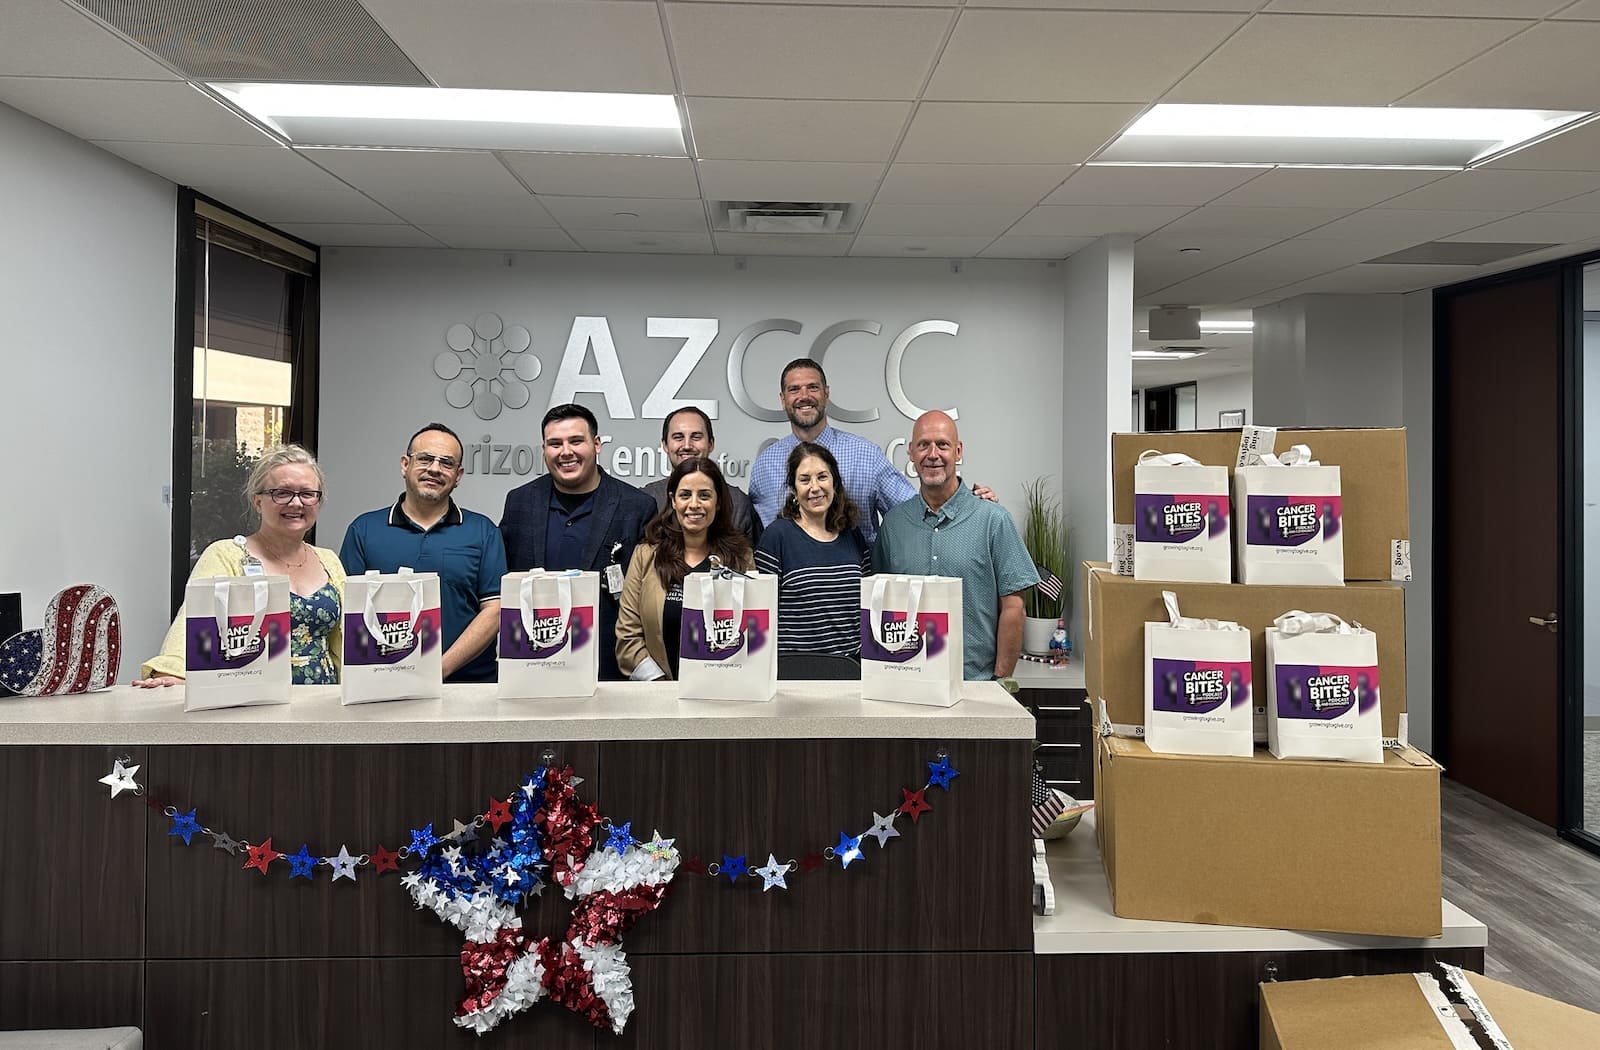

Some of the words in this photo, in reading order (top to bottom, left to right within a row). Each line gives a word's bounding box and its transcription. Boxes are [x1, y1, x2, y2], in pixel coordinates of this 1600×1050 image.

[547, 315, 960, 423] AZCCC
[717, 453, 749, 477] for
[1163, 503, 1201, 514] CANCER
[1276, 504, 1316, 516] CANCER
[1165, 511, 1201, 525] BITES
[1278, 513, 1316, 528] BITES
[380, 620, 411, 632] ANCE
[884, 621, 919, 631] CANCR
[1184, 670, 1223, 681] CANCER
[1308, 675, 1350, 686] CANCER
[1186, 680, 1223, 694] BITES
[1310, 685, 1350, 699] BITES
